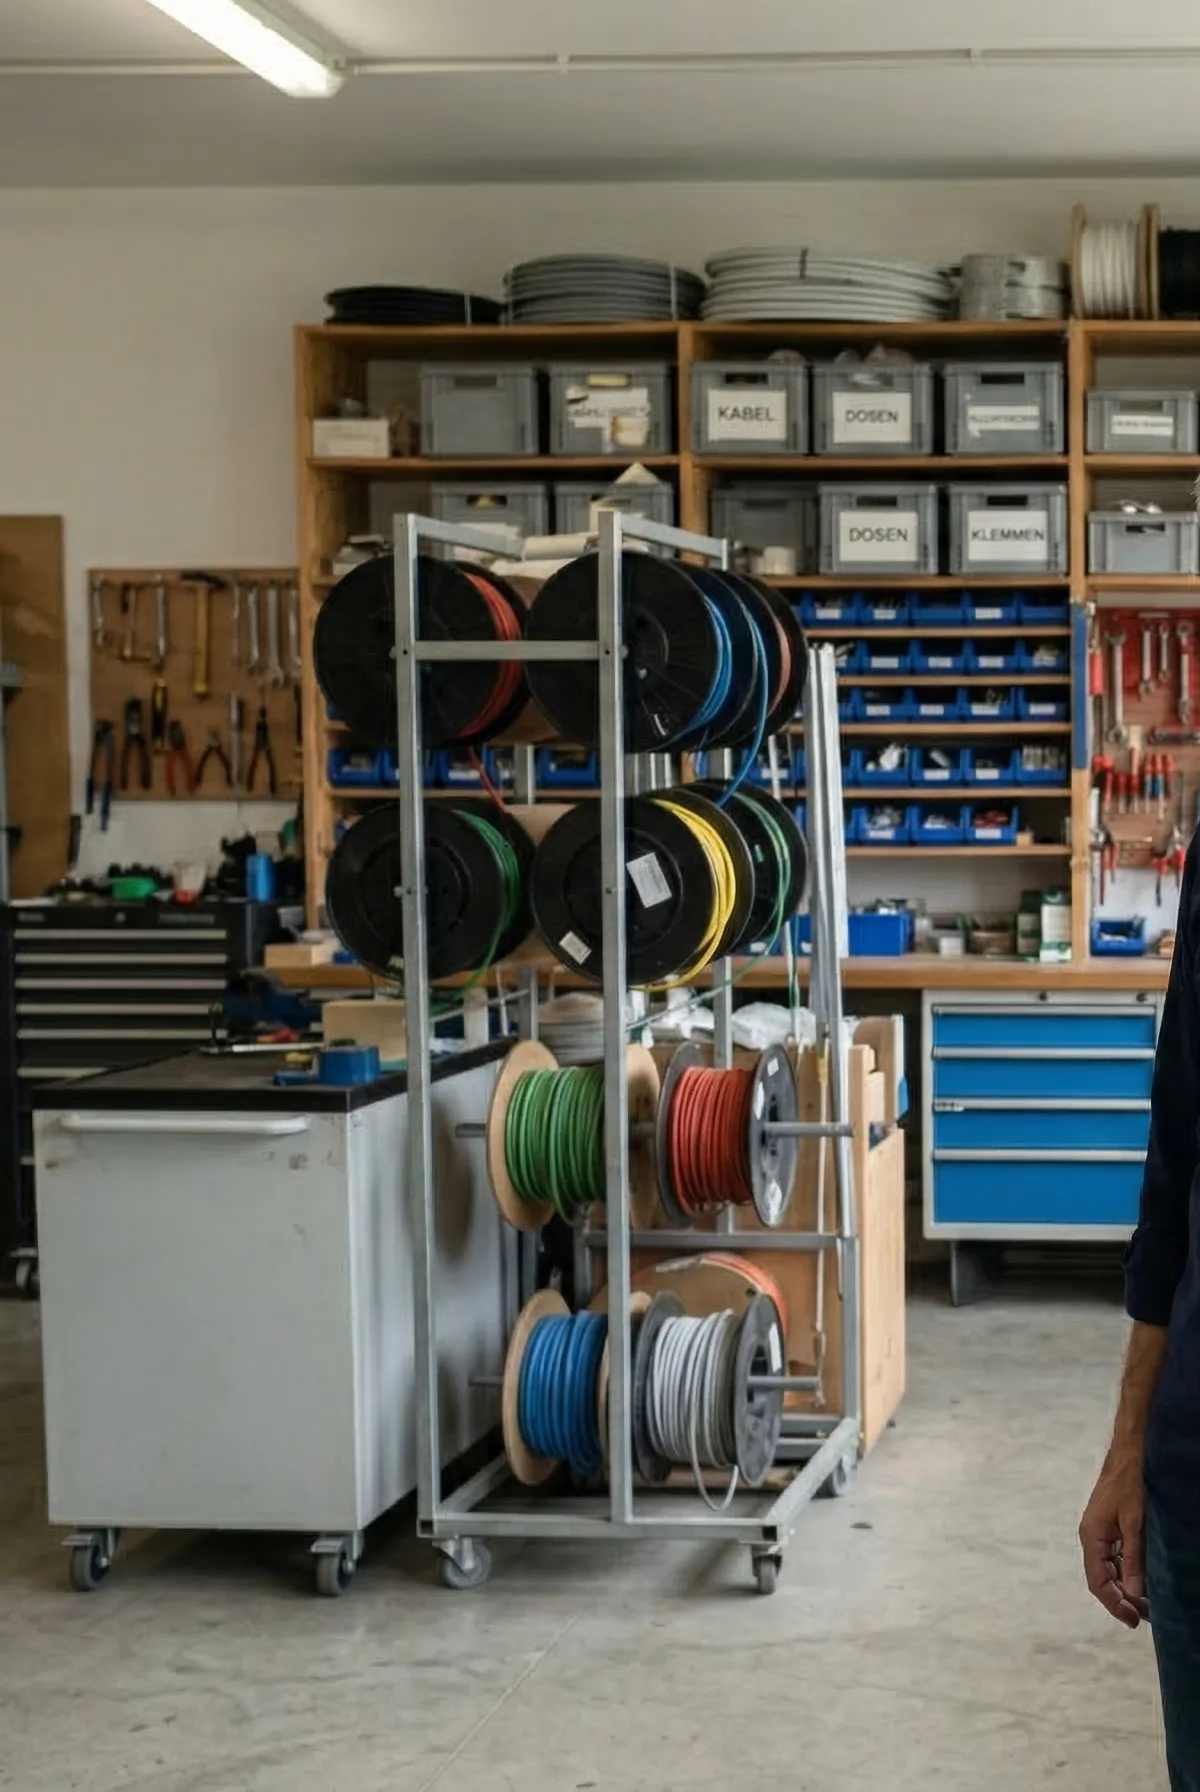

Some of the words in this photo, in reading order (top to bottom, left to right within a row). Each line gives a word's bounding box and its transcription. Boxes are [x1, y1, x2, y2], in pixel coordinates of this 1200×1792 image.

[718, 406, 775, 422] KABEL
[845, 409, 899, 424] DOSEN
[849, 527, 908, 542] DOSEN
[971, 528, 1044, 541] KLEMMEN
